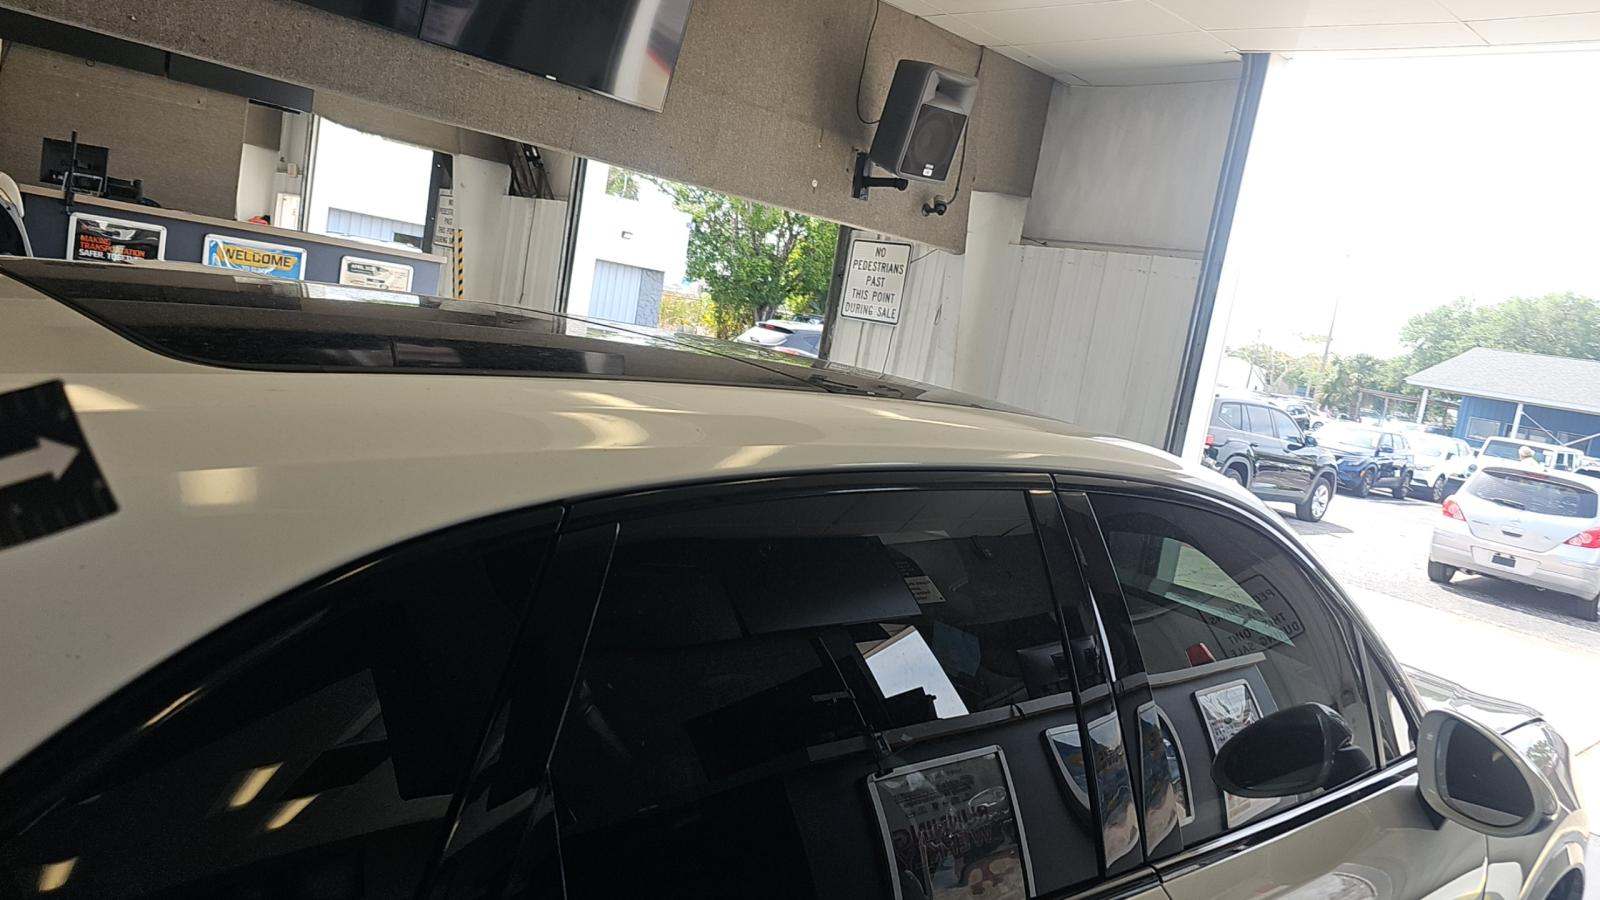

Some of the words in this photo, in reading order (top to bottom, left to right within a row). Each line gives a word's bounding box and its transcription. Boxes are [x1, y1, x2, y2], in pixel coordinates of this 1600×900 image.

[224, 248, 291, 268] WELCOME
[875, 246, 887, 258] NO
[852, 259, 905, 275] PEDESTRIANS
[865, 275, 886, 288] PAST
[852, 288, 869, 300] THIS
[871, 291, 896, 304] POINT
[844, 301, 874, 316] DURING
[876, 306, 897, 320] SALE
